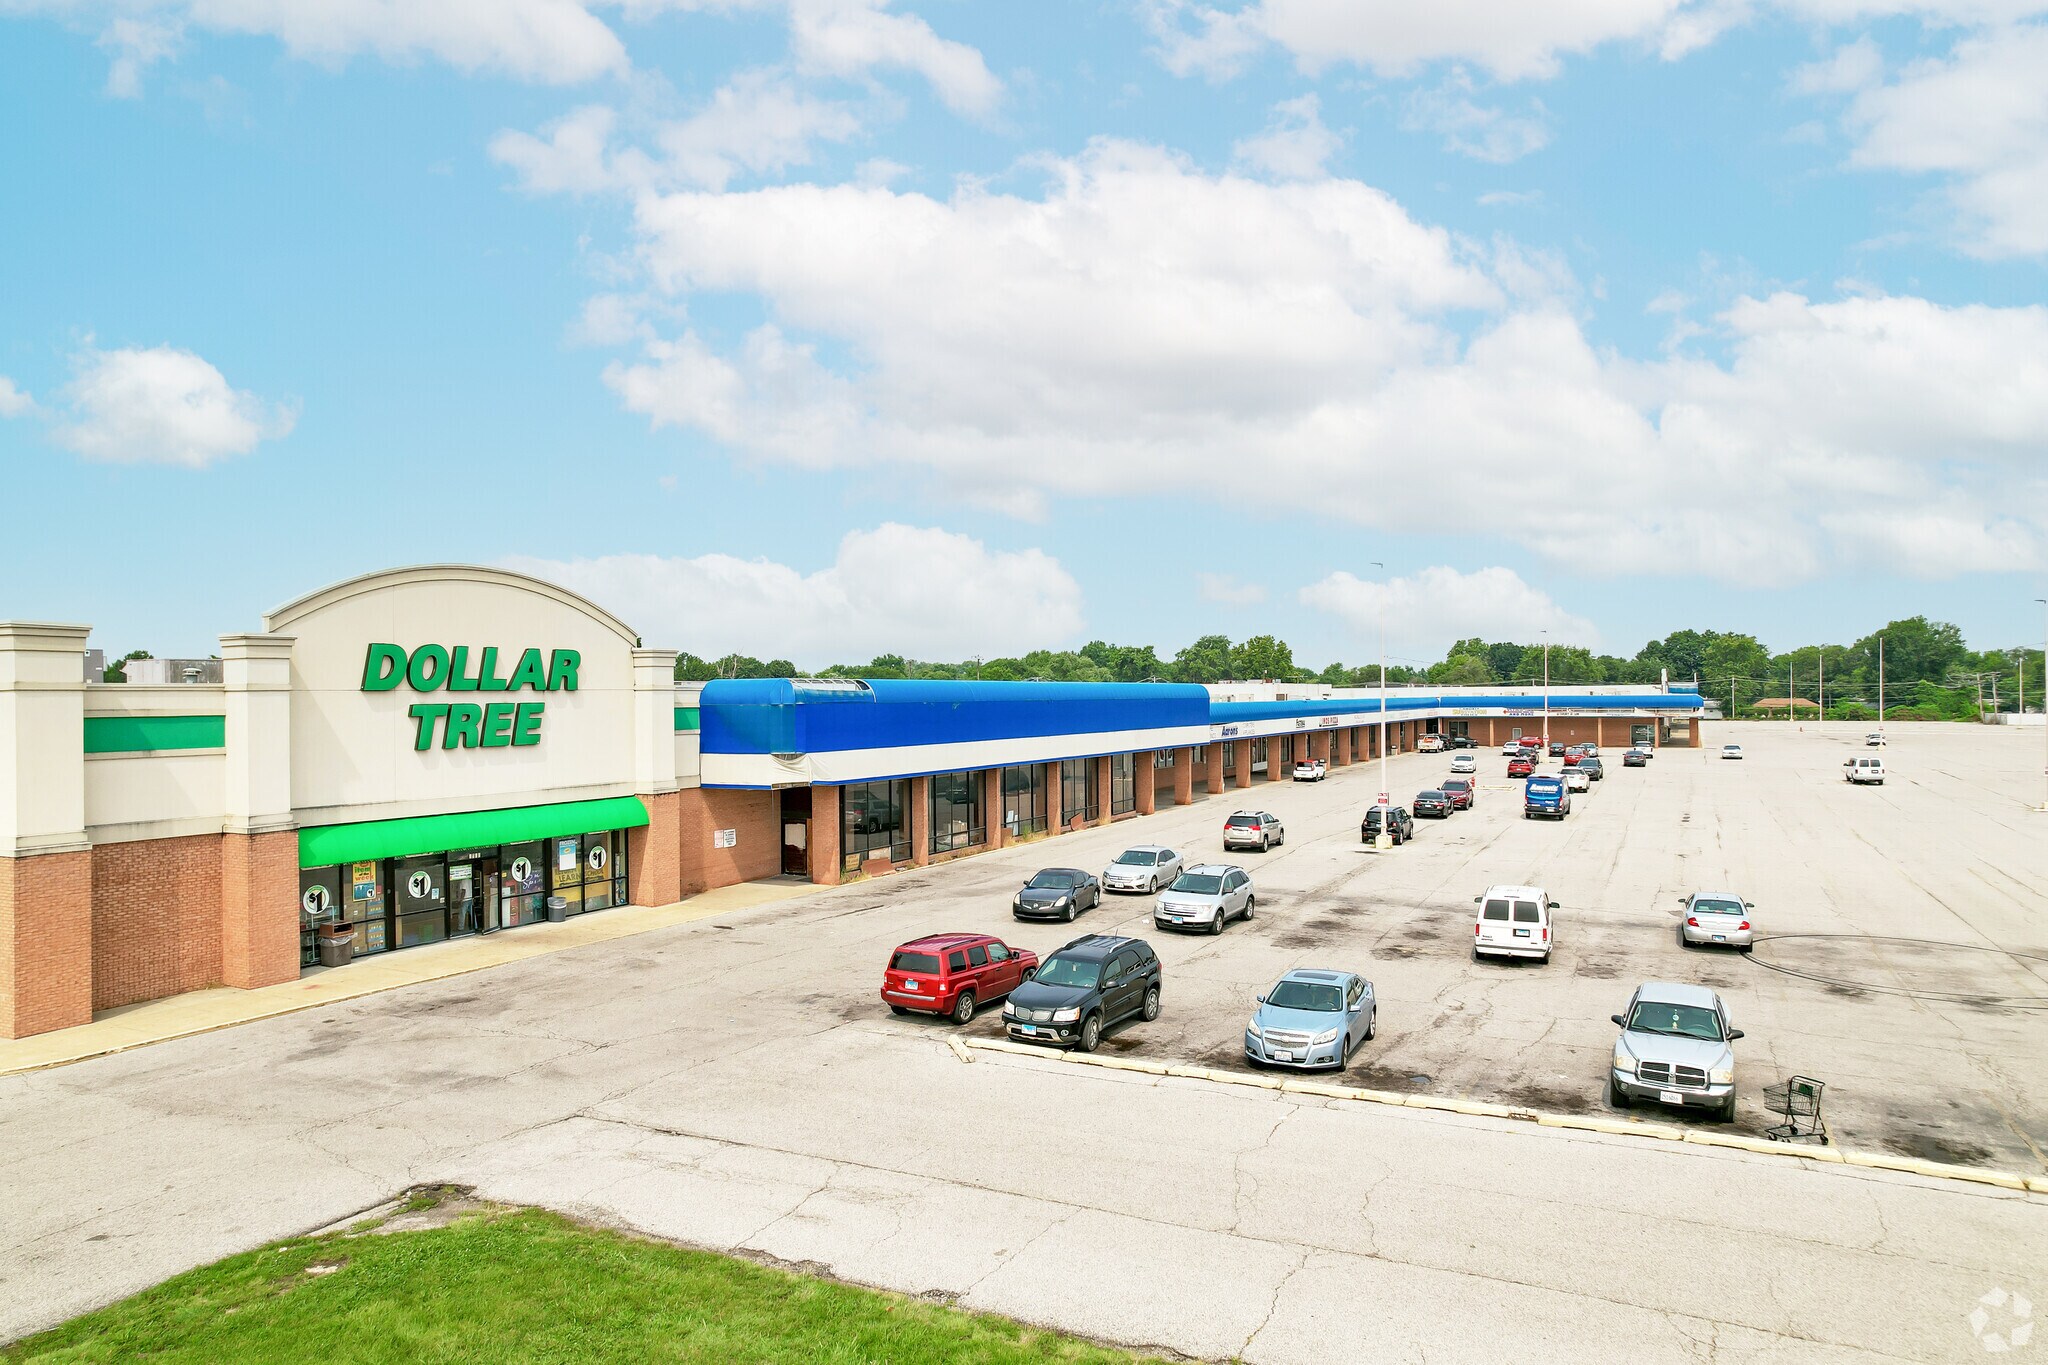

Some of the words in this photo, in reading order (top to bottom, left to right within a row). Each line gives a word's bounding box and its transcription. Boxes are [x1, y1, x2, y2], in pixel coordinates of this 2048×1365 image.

[361, 643, 581, 692] DOLLAR
[408, 702, 545, 751] TREE
[515, 862, 526, 880] $1
[413, 876, 426, 896] $1
[308, 890, 323, 912] $1
